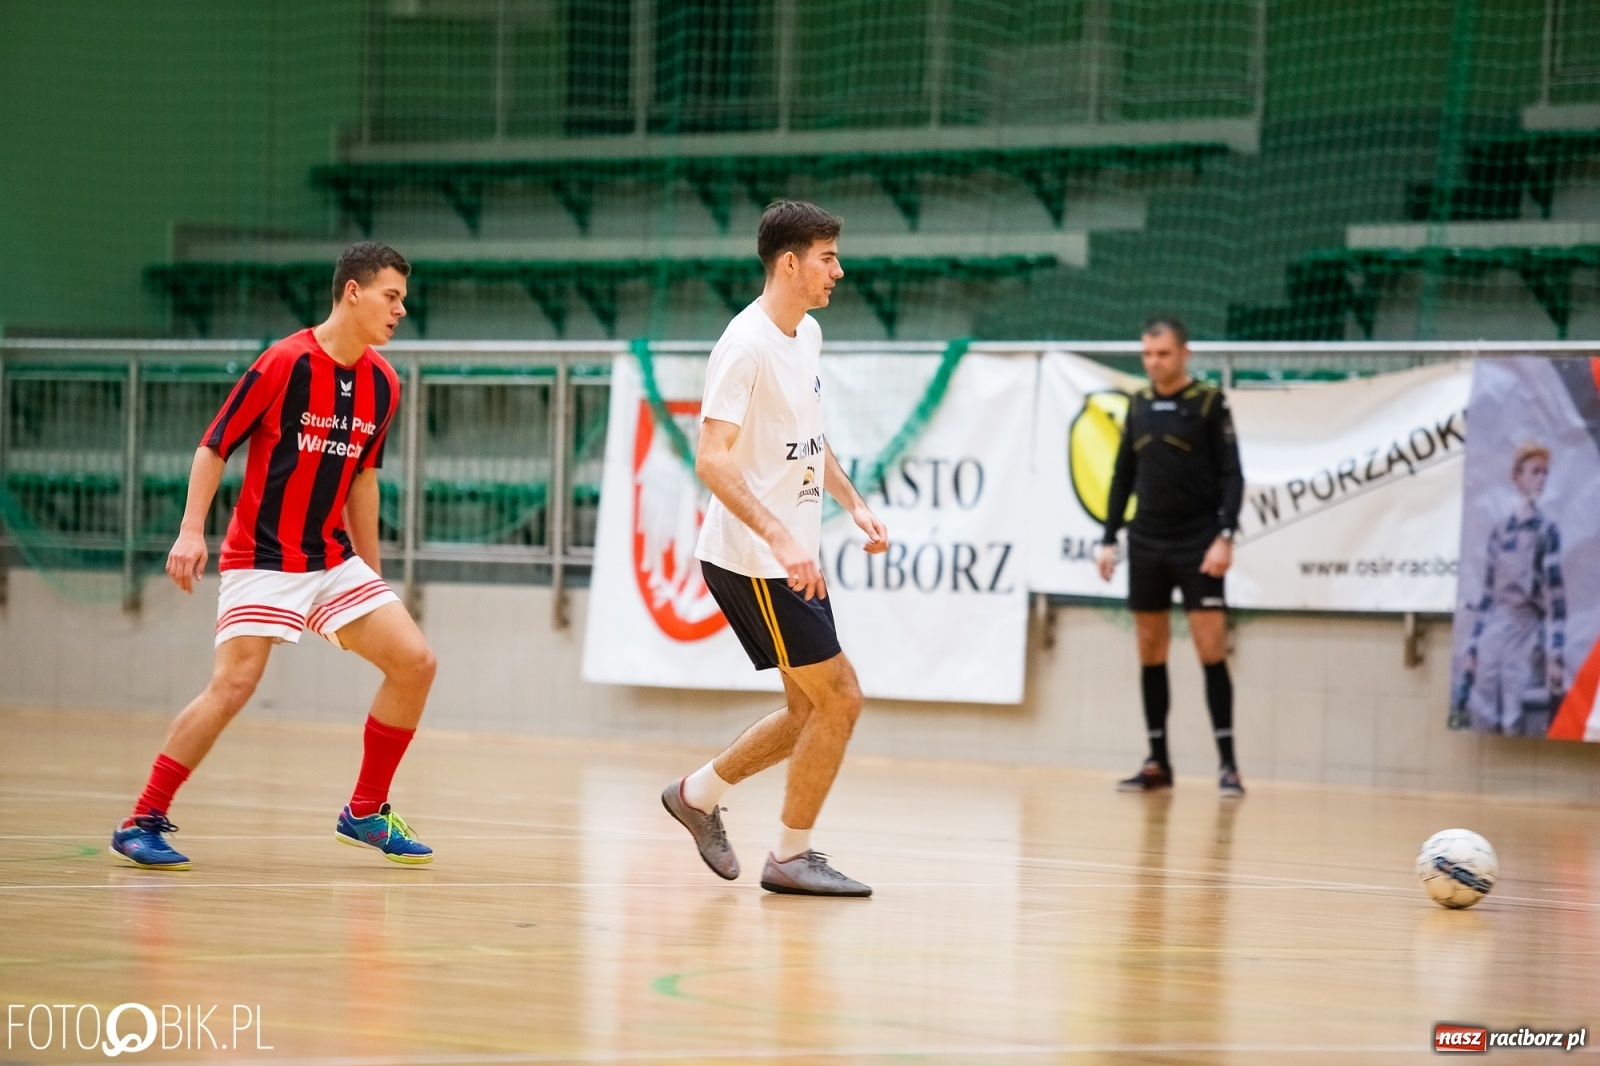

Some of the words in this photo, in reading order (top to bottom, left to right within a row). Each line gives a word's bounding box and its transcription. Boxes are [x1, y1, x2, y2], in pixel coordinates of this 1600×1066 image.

[300, 411, 339, 429] Stuck
[340, 415, 348, 430] &
[351, 416, 376, 435] Putz
[297, 432, 364, 459] Warzech
[1250, 486, 1280, 525] W
[1286, 408, 1468, 512] PORZĄDK
